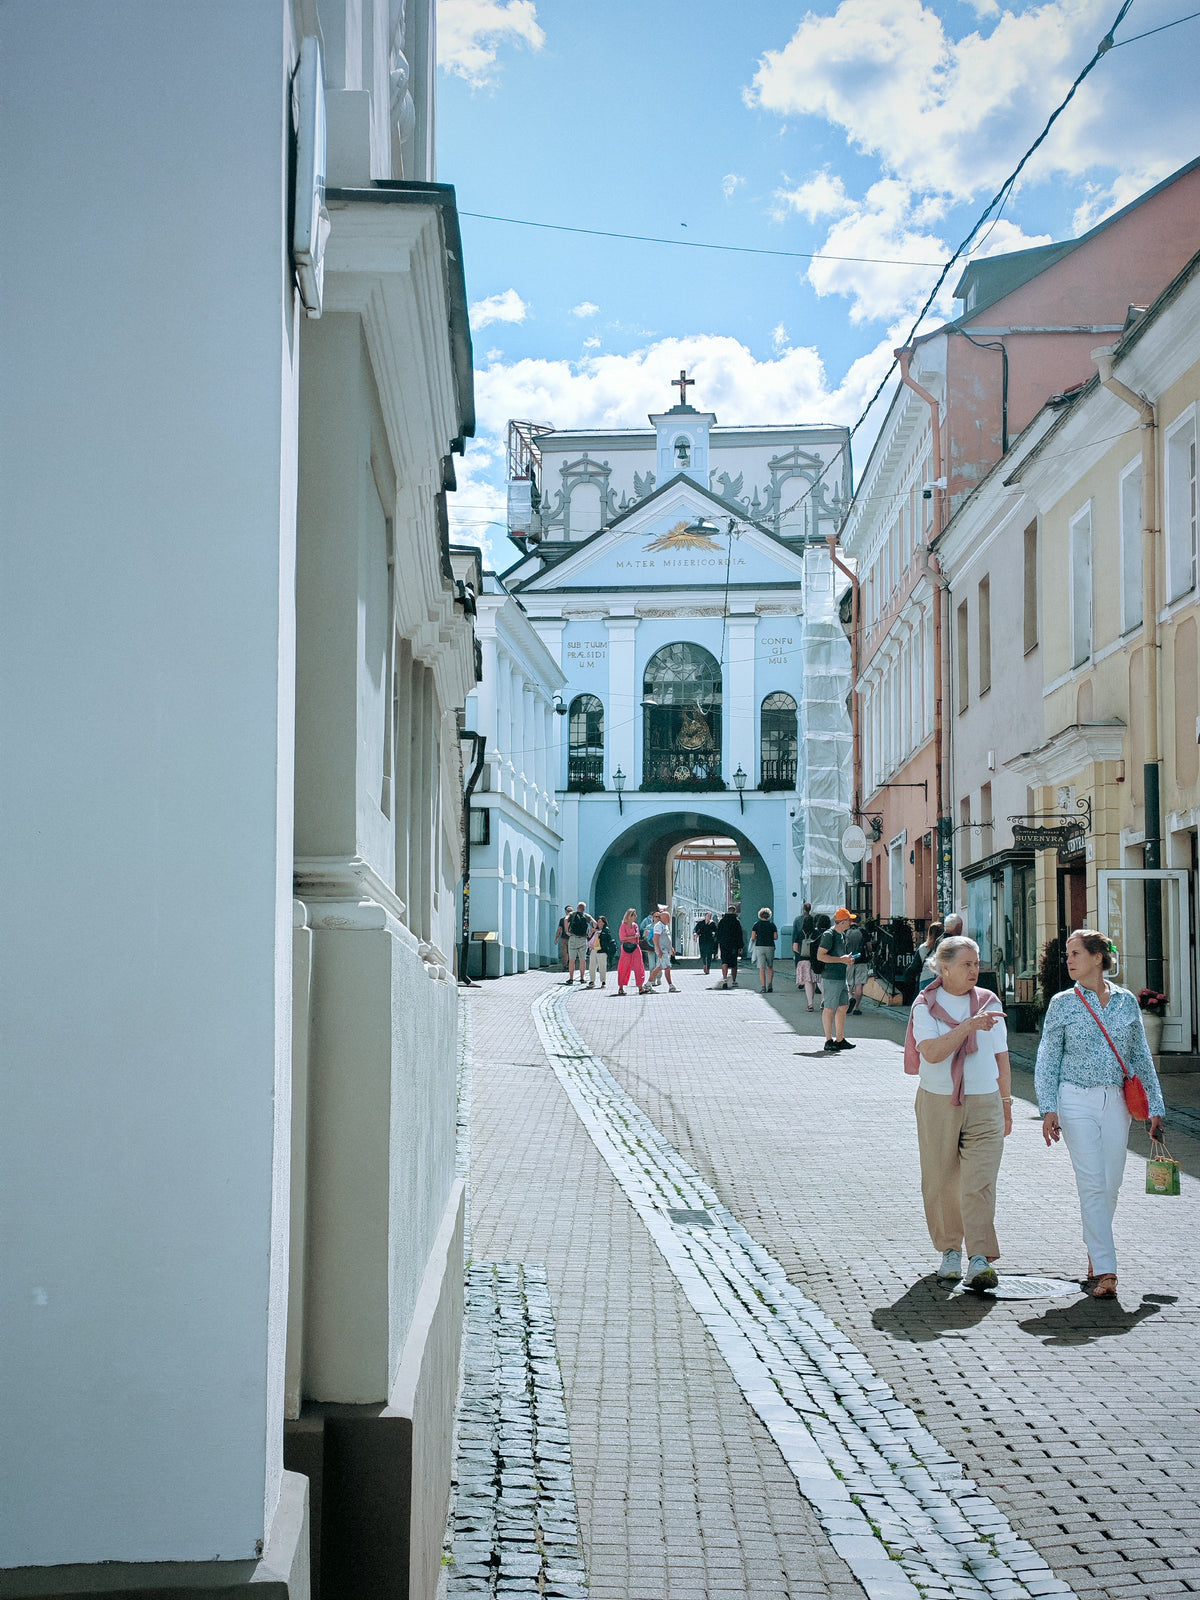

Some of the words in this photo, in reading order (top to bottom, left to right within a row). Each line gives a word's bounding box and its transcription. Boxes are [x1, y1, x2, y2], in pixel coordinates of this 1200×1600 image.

[616, 560, 655, 568] MATER
[567, 641, 582, 649] SUB
[584, 641, 608, 649] TUUM
[567, 651, 606, 659] PRÆSIDI
[771, 647, 783, 655] GI
[768, 656, 788, 665] MUS
